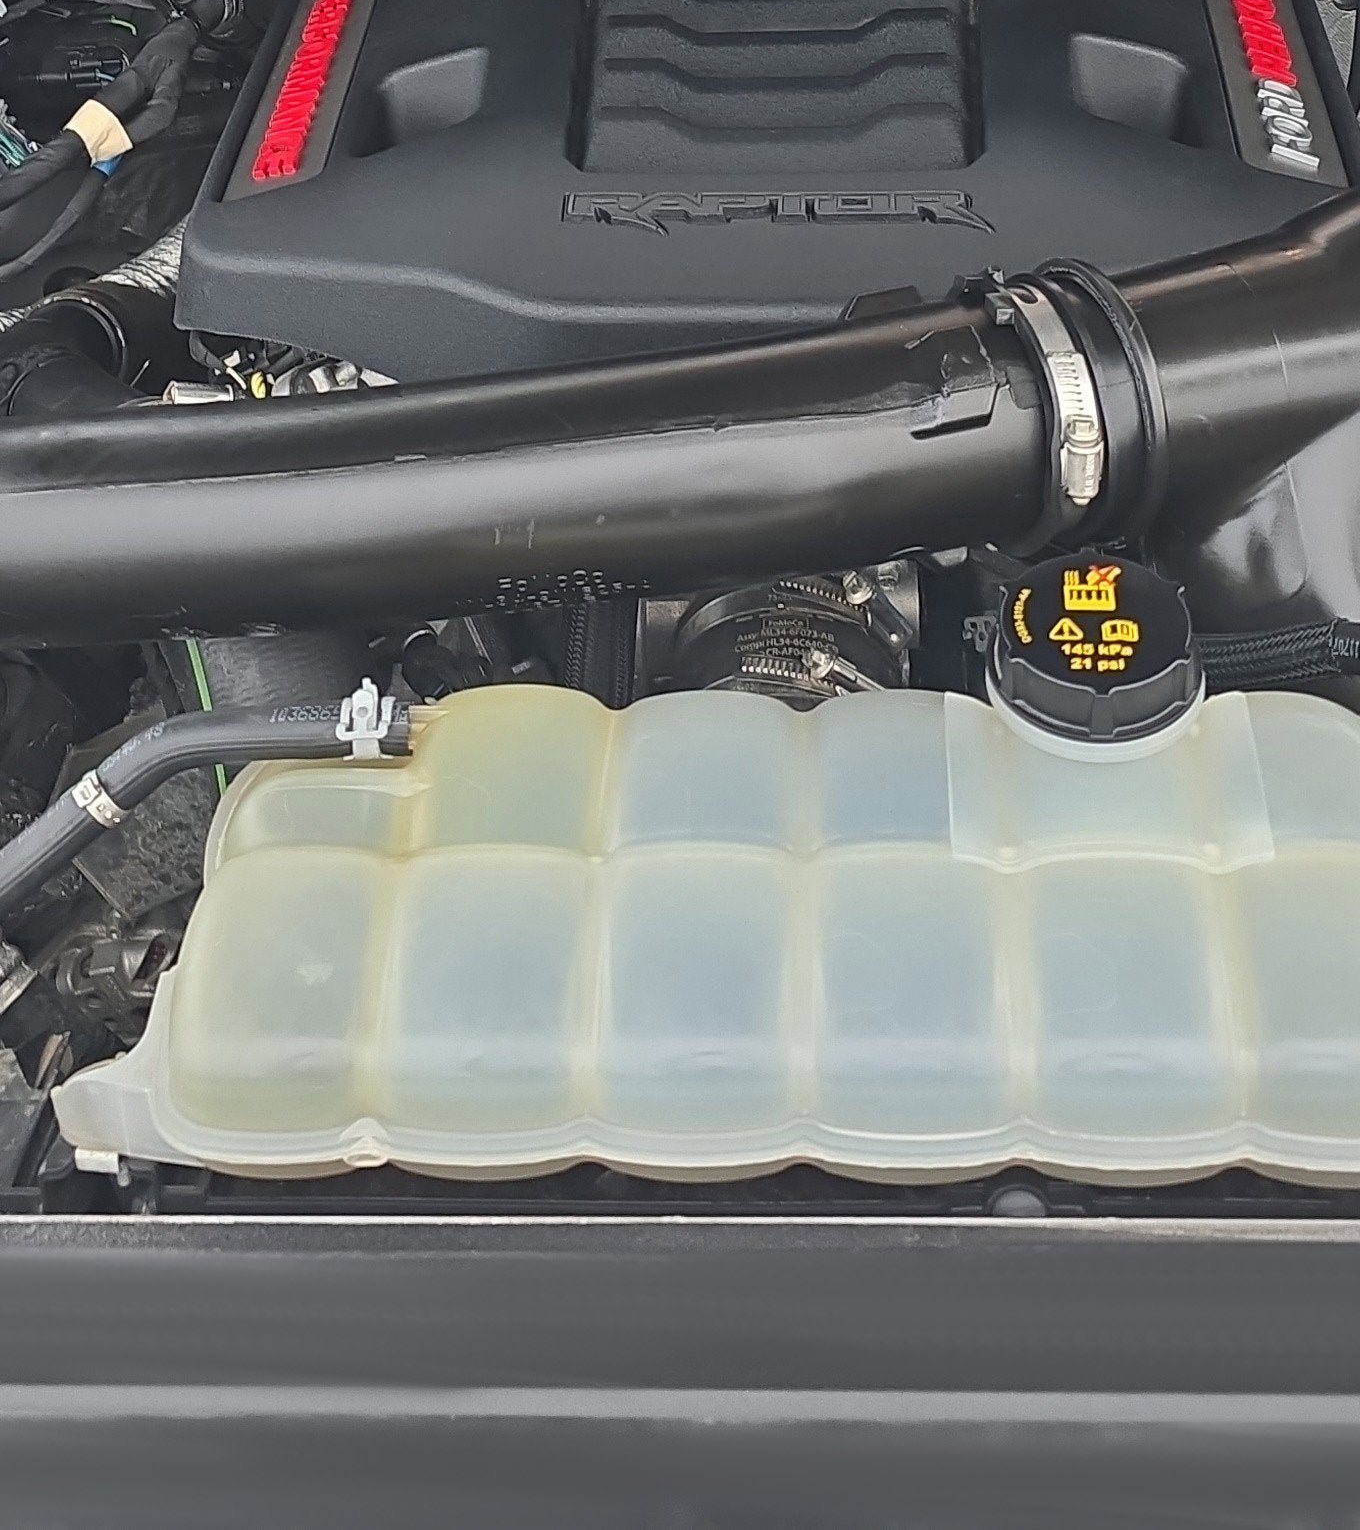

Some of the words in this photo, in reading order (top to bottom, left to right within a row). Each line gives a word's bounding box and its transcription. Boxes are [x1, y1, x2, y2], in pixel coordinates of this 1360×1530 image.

[1256, 78, 1321, 170] FORD
[561, 189, 997, 238] RAPTOR
[1060, 643, 1095, 656] 145
[1097, 643, 1134, 657] kPa
[1070, 657, 1092, 670] 21
[1097, 658, 1126, 673] psi
